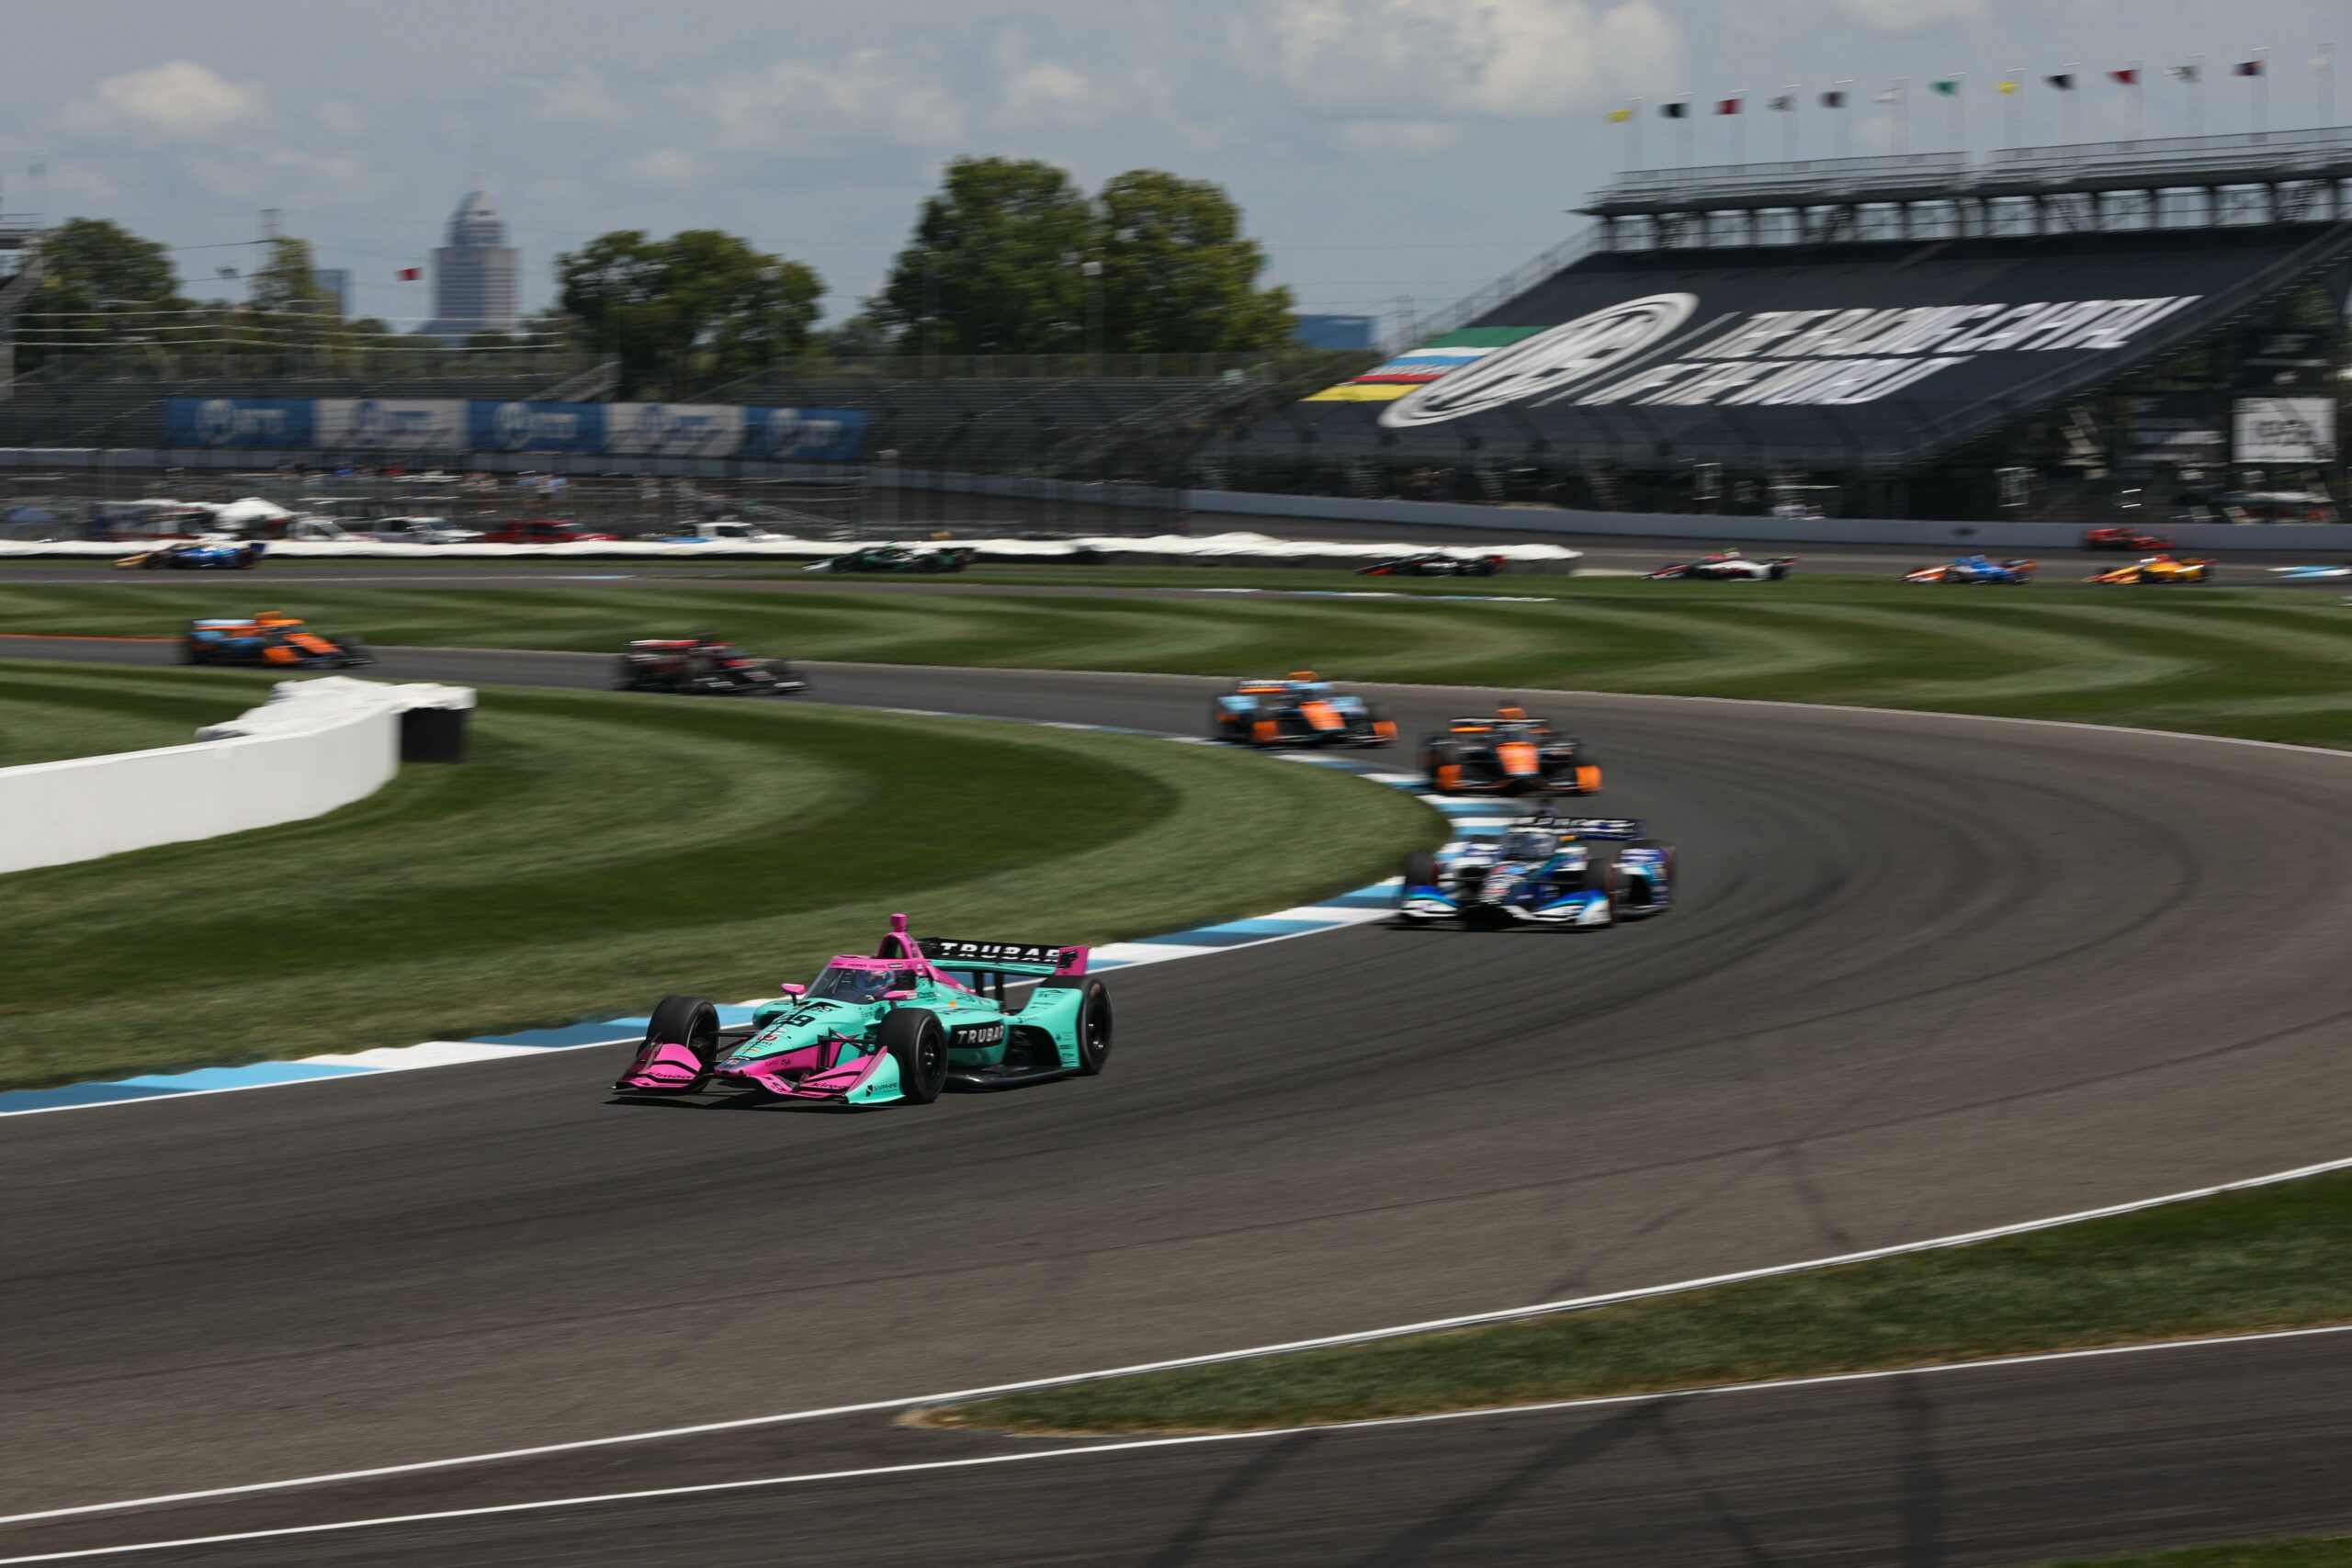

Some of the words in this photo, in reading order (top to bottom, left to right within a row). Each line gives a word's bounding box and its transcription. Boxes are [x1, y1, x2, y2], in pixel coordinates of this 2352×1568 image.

[1675, 308, 1846, 360] THE
[1757, 303, 2009, 356] RACING
[1931, 295, 2204, 354] CAPITAL
[1570, 362, 1715, 407] OF
[1630, 359, 1798, 407] THE
[1713, 355, 1978, 407] WORLD
[940, 942, 1059, 963] TRUBAR
